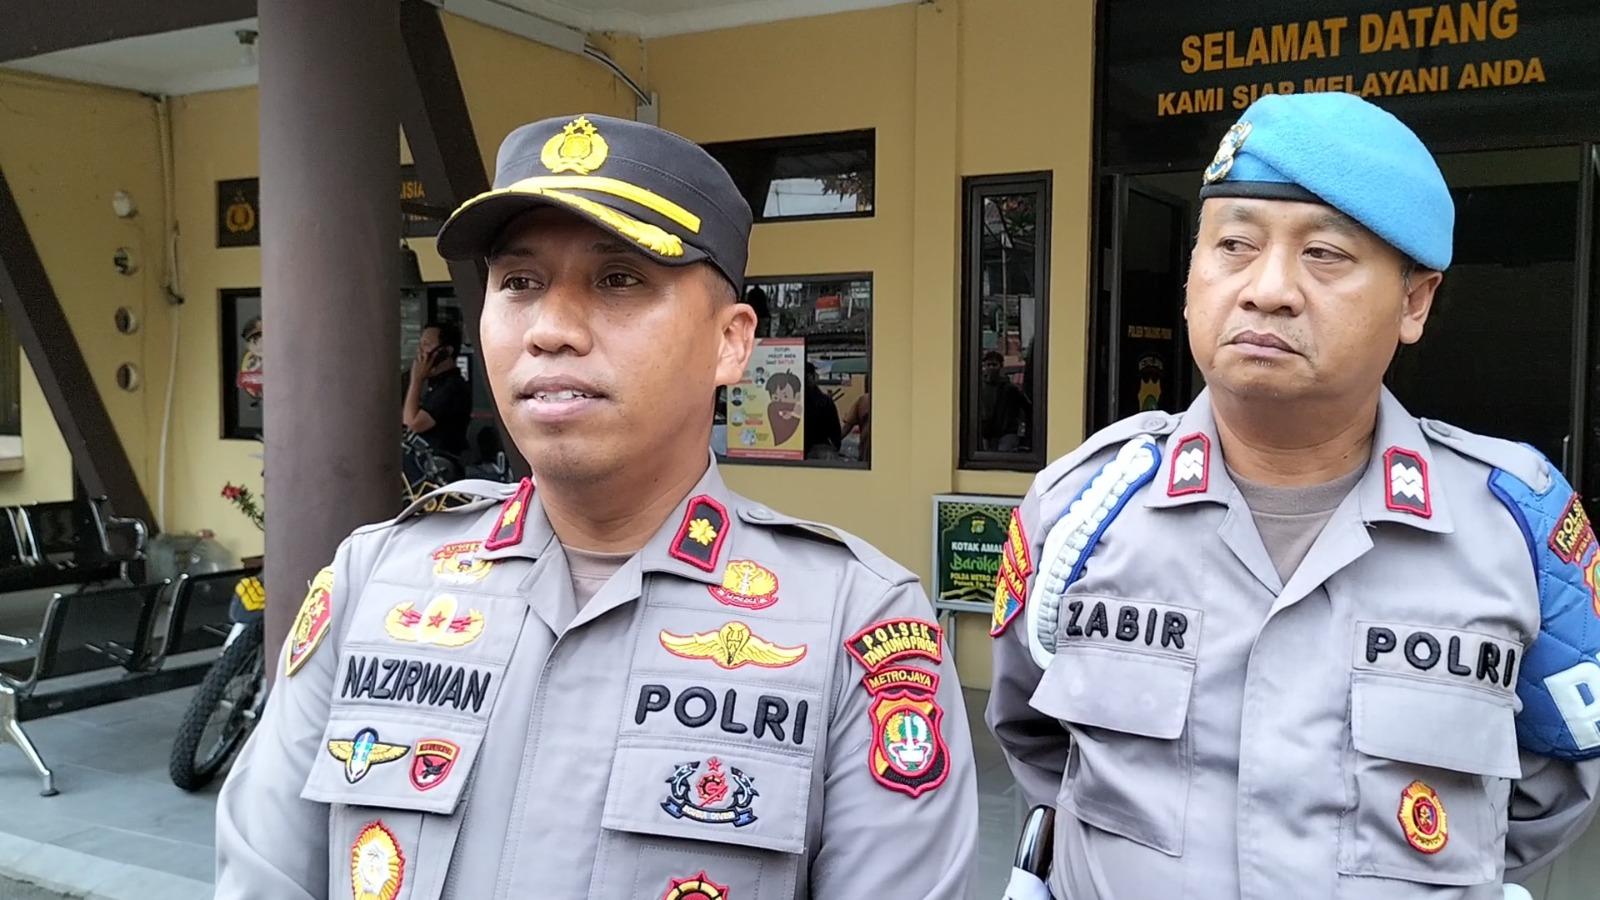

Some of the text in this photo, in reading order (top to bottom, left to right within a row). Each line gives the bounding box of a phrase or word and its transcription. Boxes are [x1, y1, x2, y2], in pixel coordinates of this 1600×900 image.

[1181, 0, 1519, 74] SELAMAT DATANG
[1157, 86, 1224, 117] KAMI
[1458, 57, 1546, 89] ANDA
[951, 541, 1004, 554] KOTAK AMAL
[861, 622, 931, 650] POLSEK
[1066, 600, 1188, 650] ZABIR
[341, 654, 492, 713] NAZIRWAN
[1366, 626, 1516, 688] POLRI
[635, 684, 809, 746] POLRI
